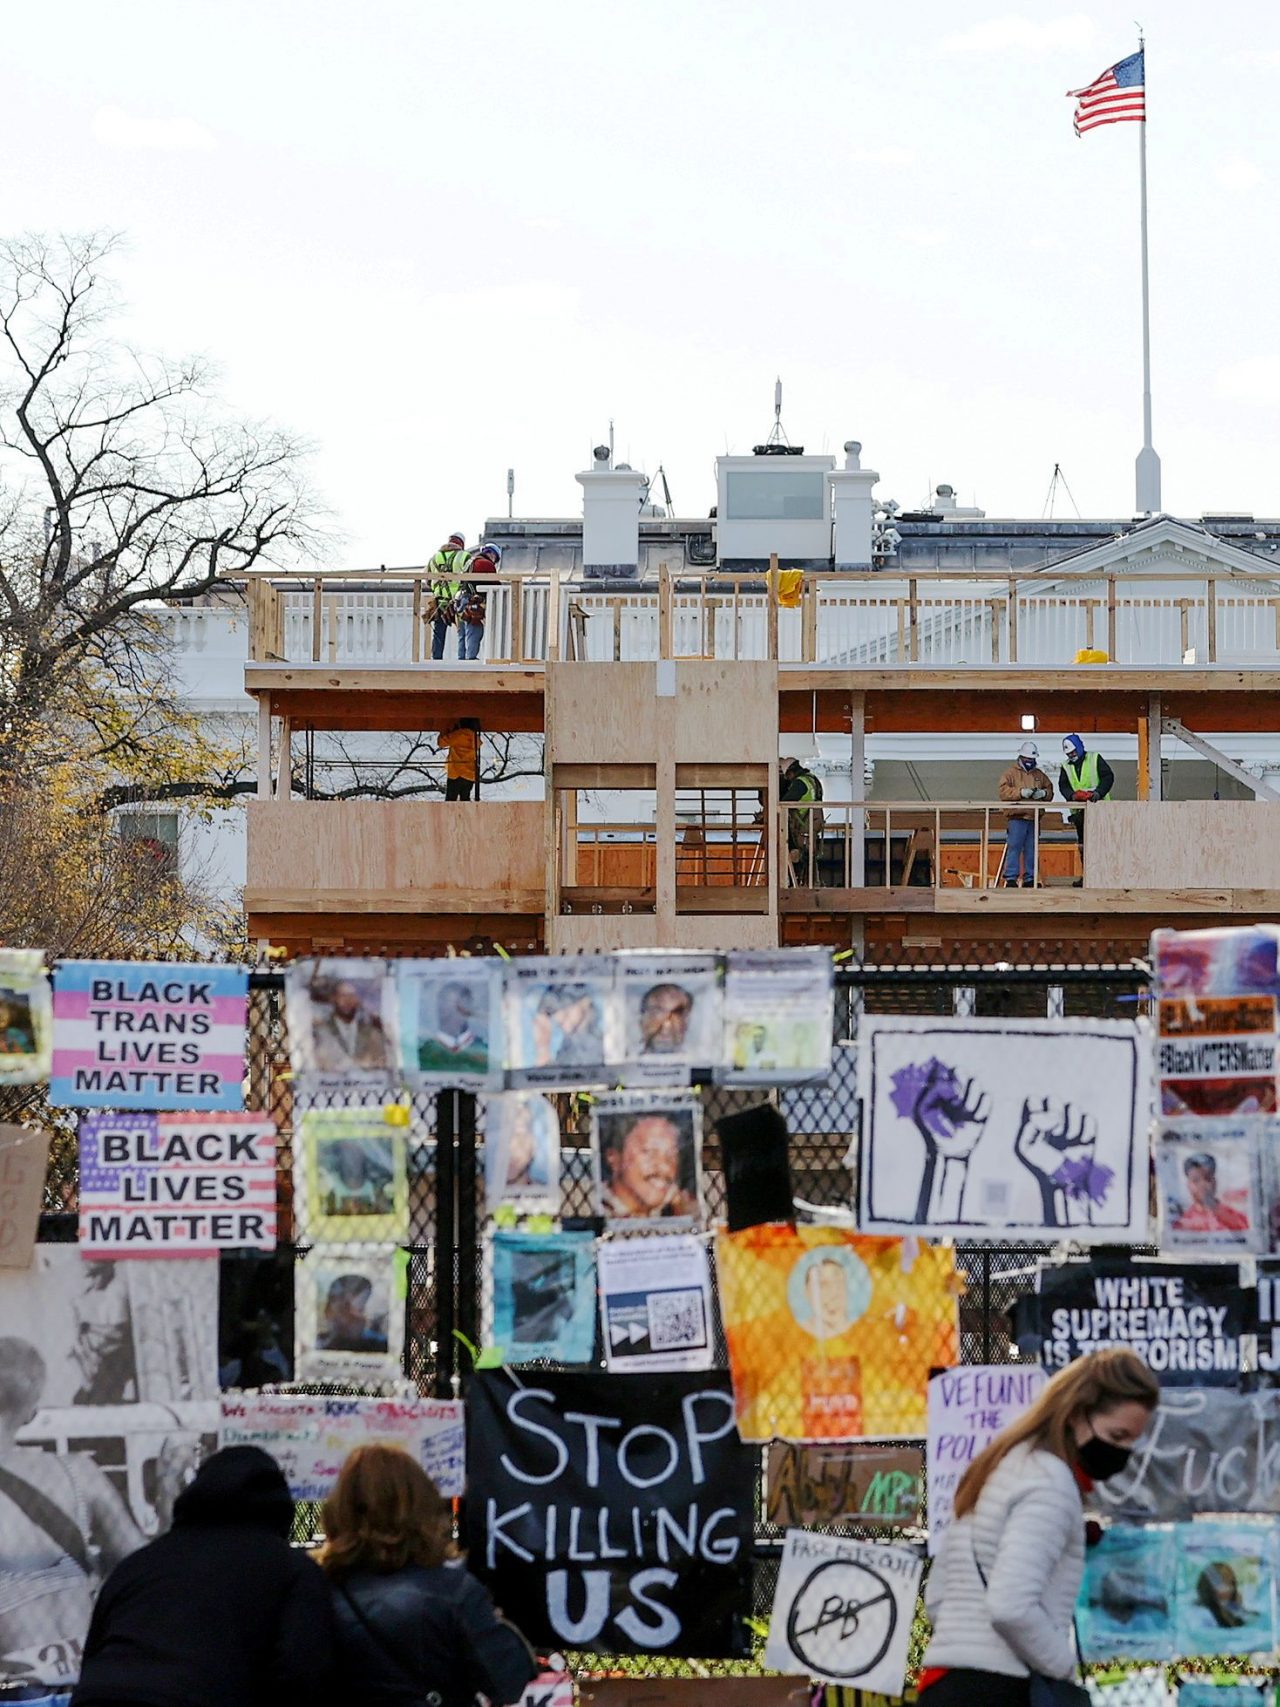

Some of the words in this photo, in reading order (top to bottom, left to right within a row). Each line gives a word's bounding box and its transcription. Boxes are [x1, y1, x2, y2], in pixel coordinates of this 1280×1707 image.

[92, 980, 211, 1005] BLACK
[91, 1011, 210, 1034] TRANS
[98, 1040, 200, 1064] LIVES
[75, 1070, 220, 1096] MATTER
[103, 1133, 259, 1162] BLACK
[124, 1175, 246, 1201] LIVES
[90, 1215, 264, 1242] MATTER
[1094, 1277, 1184, 1308] WHITE
[1051, 1306, 1228, 1340] SUPREMACY
[1043, 1340, 1070, 1368] IS
[965, 1409, 1005, 1430] THE
[501, 1387, 738, 1489] STOP
[487, 1497, 740, 1569] KILLING
[545, 1567, 682, 1648] US
